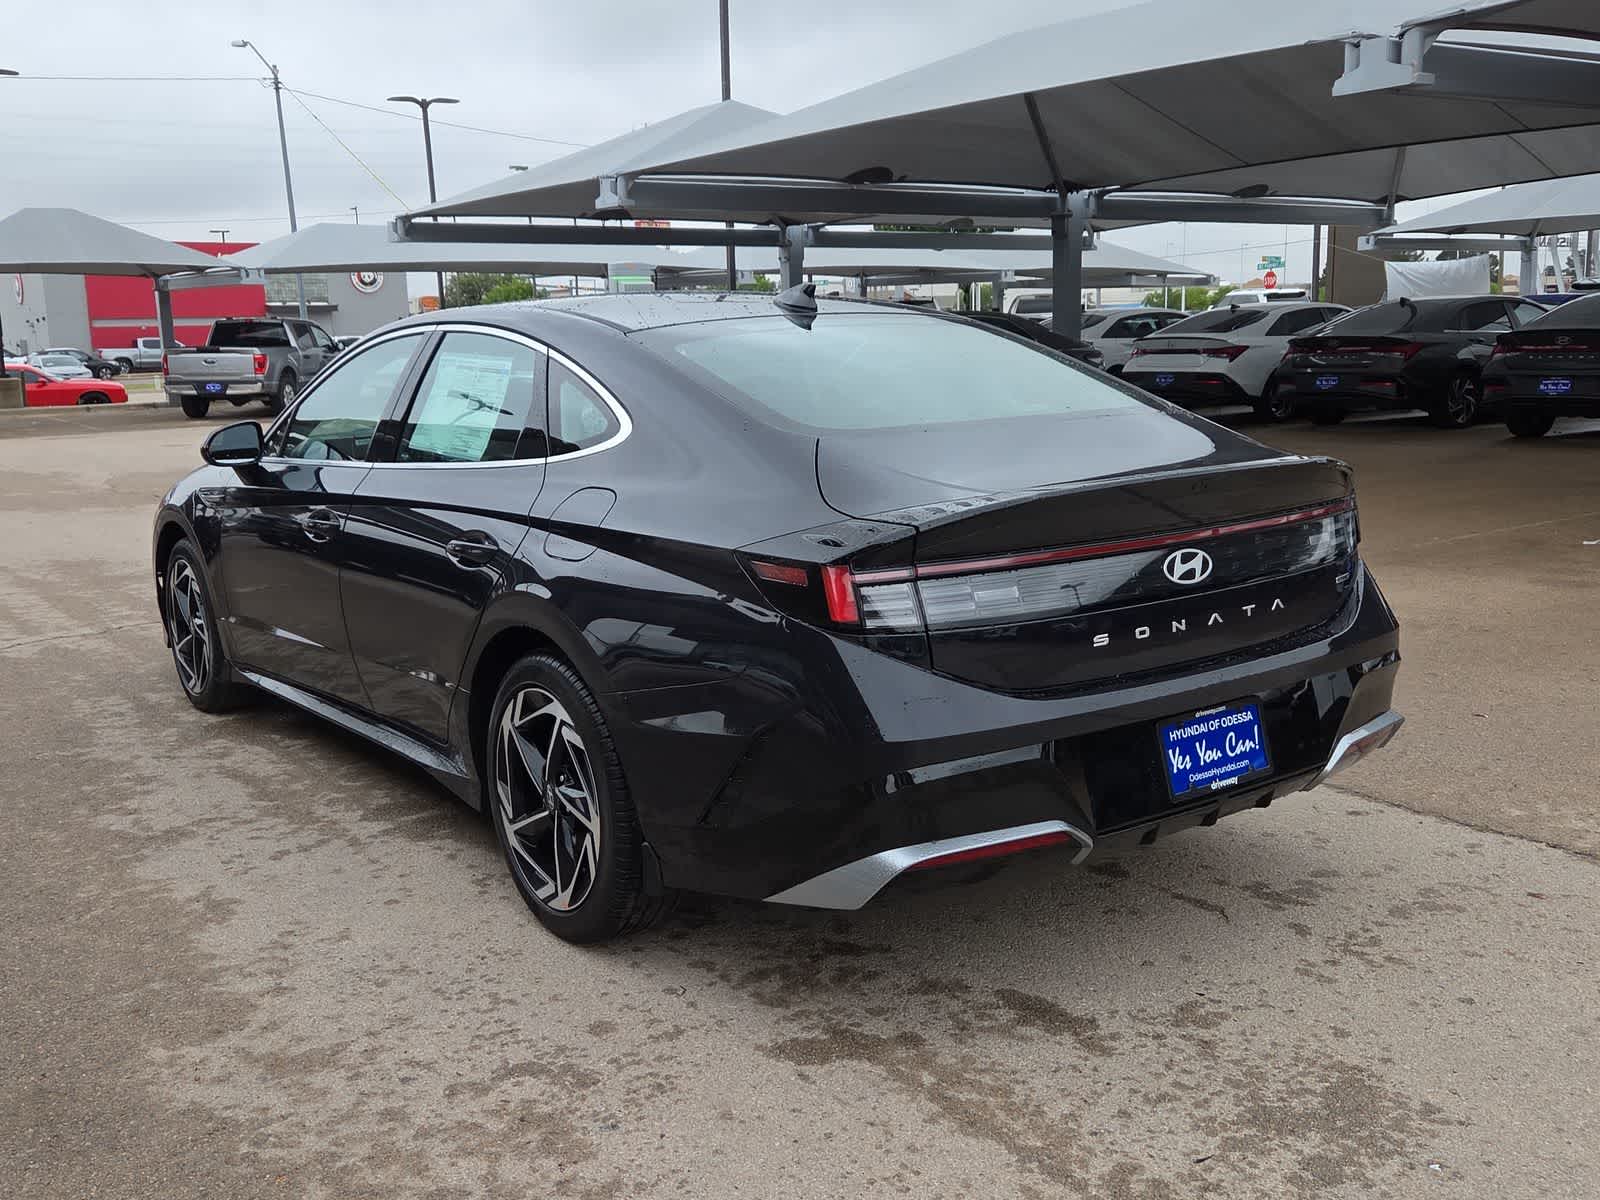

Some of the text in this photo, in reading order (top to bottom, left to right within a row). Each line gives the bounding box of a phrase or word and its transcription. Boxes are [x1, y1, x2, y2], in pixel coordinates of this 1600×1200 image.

[1264, 276, 1276, 285] STOP
[1093, 598, 1286, 648] SONATA
[1169, 711, 1254, 742] HYUNDAI OF ODESSA
[1168, 724, 1260, 774] Yes You Can!
[1189, 759, 1250, 783] OdessaHyundai.com
[1210, 776, 1238, 790] driveway
